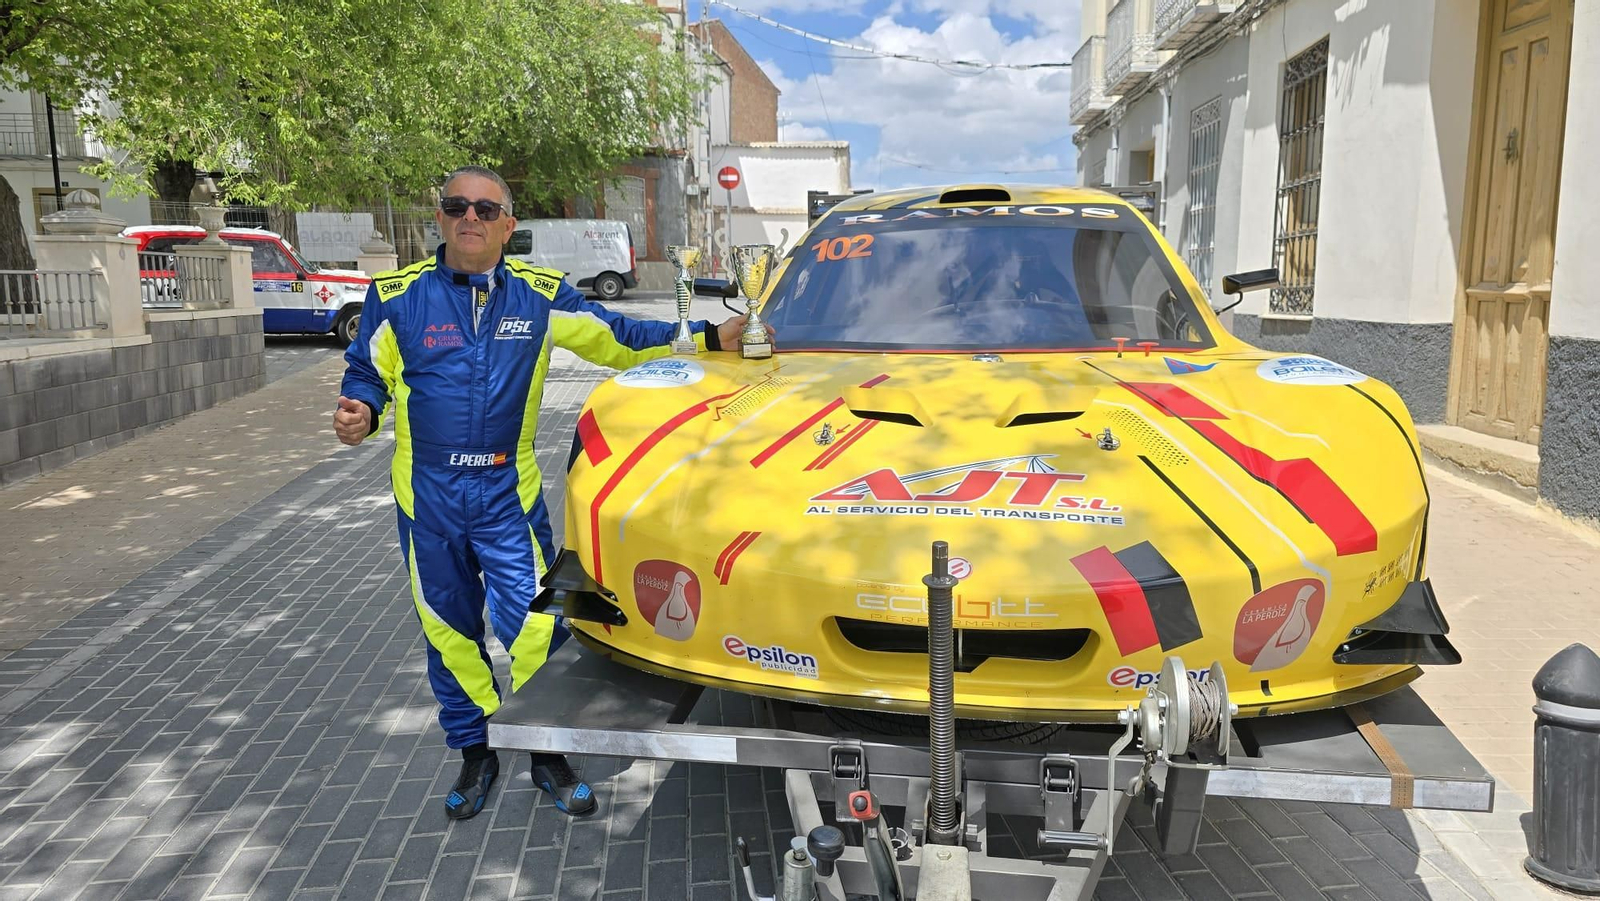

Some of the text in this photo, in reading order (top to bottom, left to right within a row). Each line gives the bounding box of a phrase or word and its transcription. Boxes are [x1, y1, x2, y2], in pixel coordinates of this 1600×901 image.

[837, 206, 1120, 226] RAMOS
[583, 230, 619, 239] Alcarent
[811, 233, 874, 262] 102
[291, 282, 303, 292] 16
[381, 282, 403, 293] OMP
[534, 278, 555, 291] OMP
[318, 290, 331, 298] CS
[499, 320, 534, 334] PSC
[810, 467, 1086, 505] AJT
[1055, 496, 1120, 512] S.L.
[806, 506, 1124, 525] AL SERVICIO DEL TRANSPORTE
[645, 579, 669, 592] PERDIZ
[870, 613, 1043, 629] PERFRMANCE
[1241, 608, 1287, 624] LA PERDIZ
[724, 637, 816, 667] epsilon
[761, 661, 817, 674] publicidad
[446, 793, 463, 806] OMP
